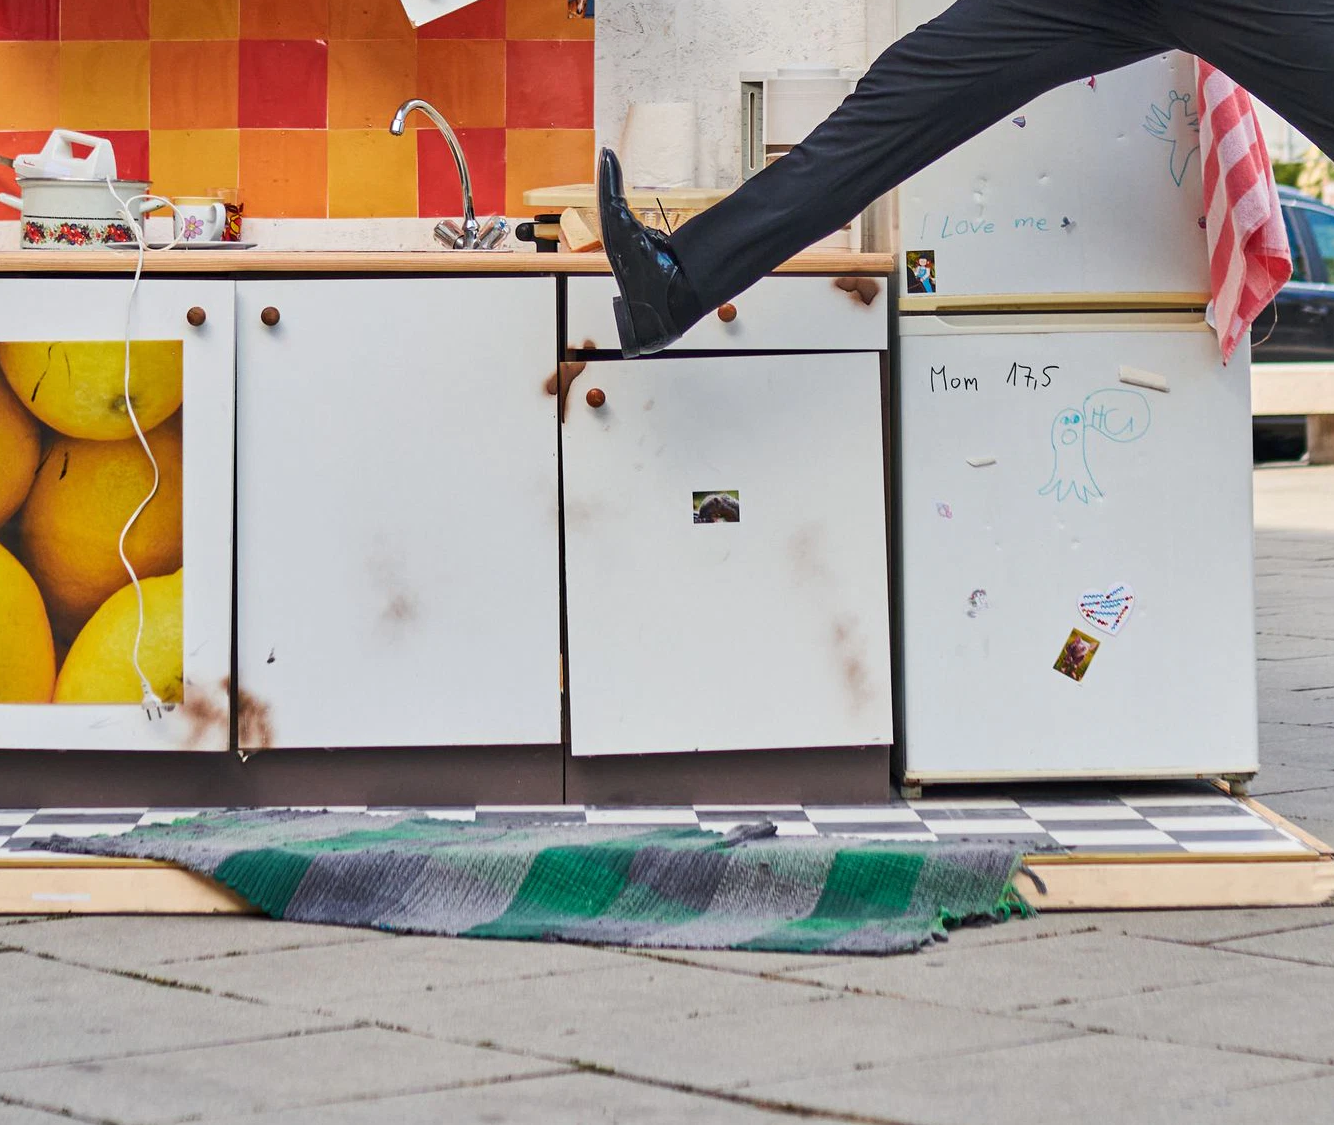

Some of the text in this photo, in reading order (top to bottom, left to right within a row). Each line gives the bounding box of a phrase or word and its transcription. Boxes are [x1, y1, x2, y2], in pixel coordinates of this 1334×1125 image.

[941, 215, 995, 239] Love
[1014, 216, 1051, 233] me
[930, 361, 1060, 393] Mom 17,5
